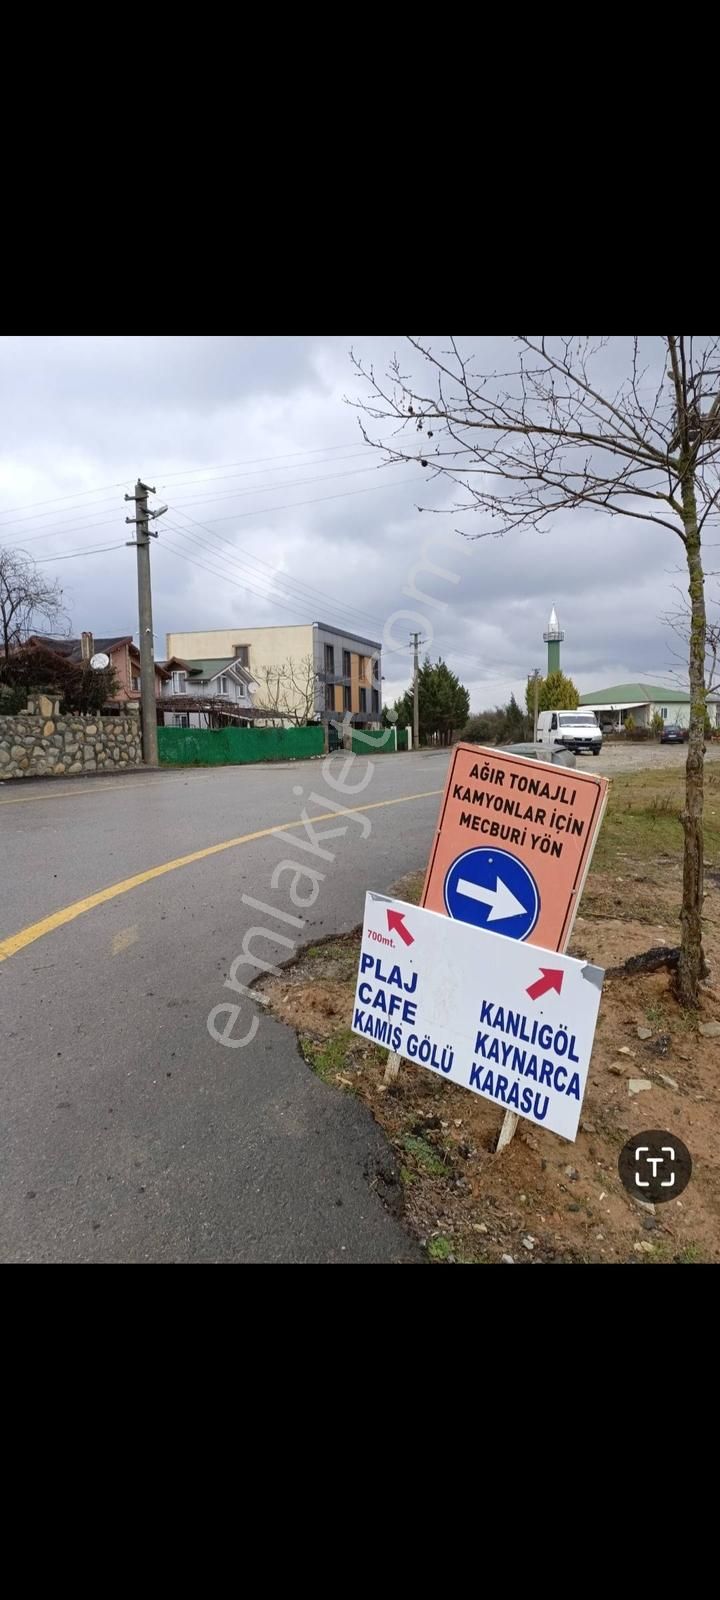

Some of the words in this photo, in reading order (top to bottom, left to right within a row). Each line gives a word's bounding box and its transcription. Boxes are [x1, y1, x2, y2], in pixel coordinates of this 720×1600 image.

[469, 762, 505, 786] AĞIR
[510, 773, 577, 806] TONAJLI
[452, 785, 546, 825] KAMYONLAR
[549, 808, 585, 837] İÇİN
[459, 812, 527, 846] MECBURİ
[531, 833, 563, 858] YÖN
[367, 929, 396, 949] 700mt.
[360, 953, 418, 994] PLAJ
[358, 982, 418, 1026] CAFE
[353, 1008, 403, 1052] KAMIŞ
[406, 1034, 455, 1074] GÖLÜ
[480, 1000, 580, 1063] KANLIGÖL
[474, 1031, 581, 1101] KAYNARCA
[469, 1062, 550, 1121] KARASU
